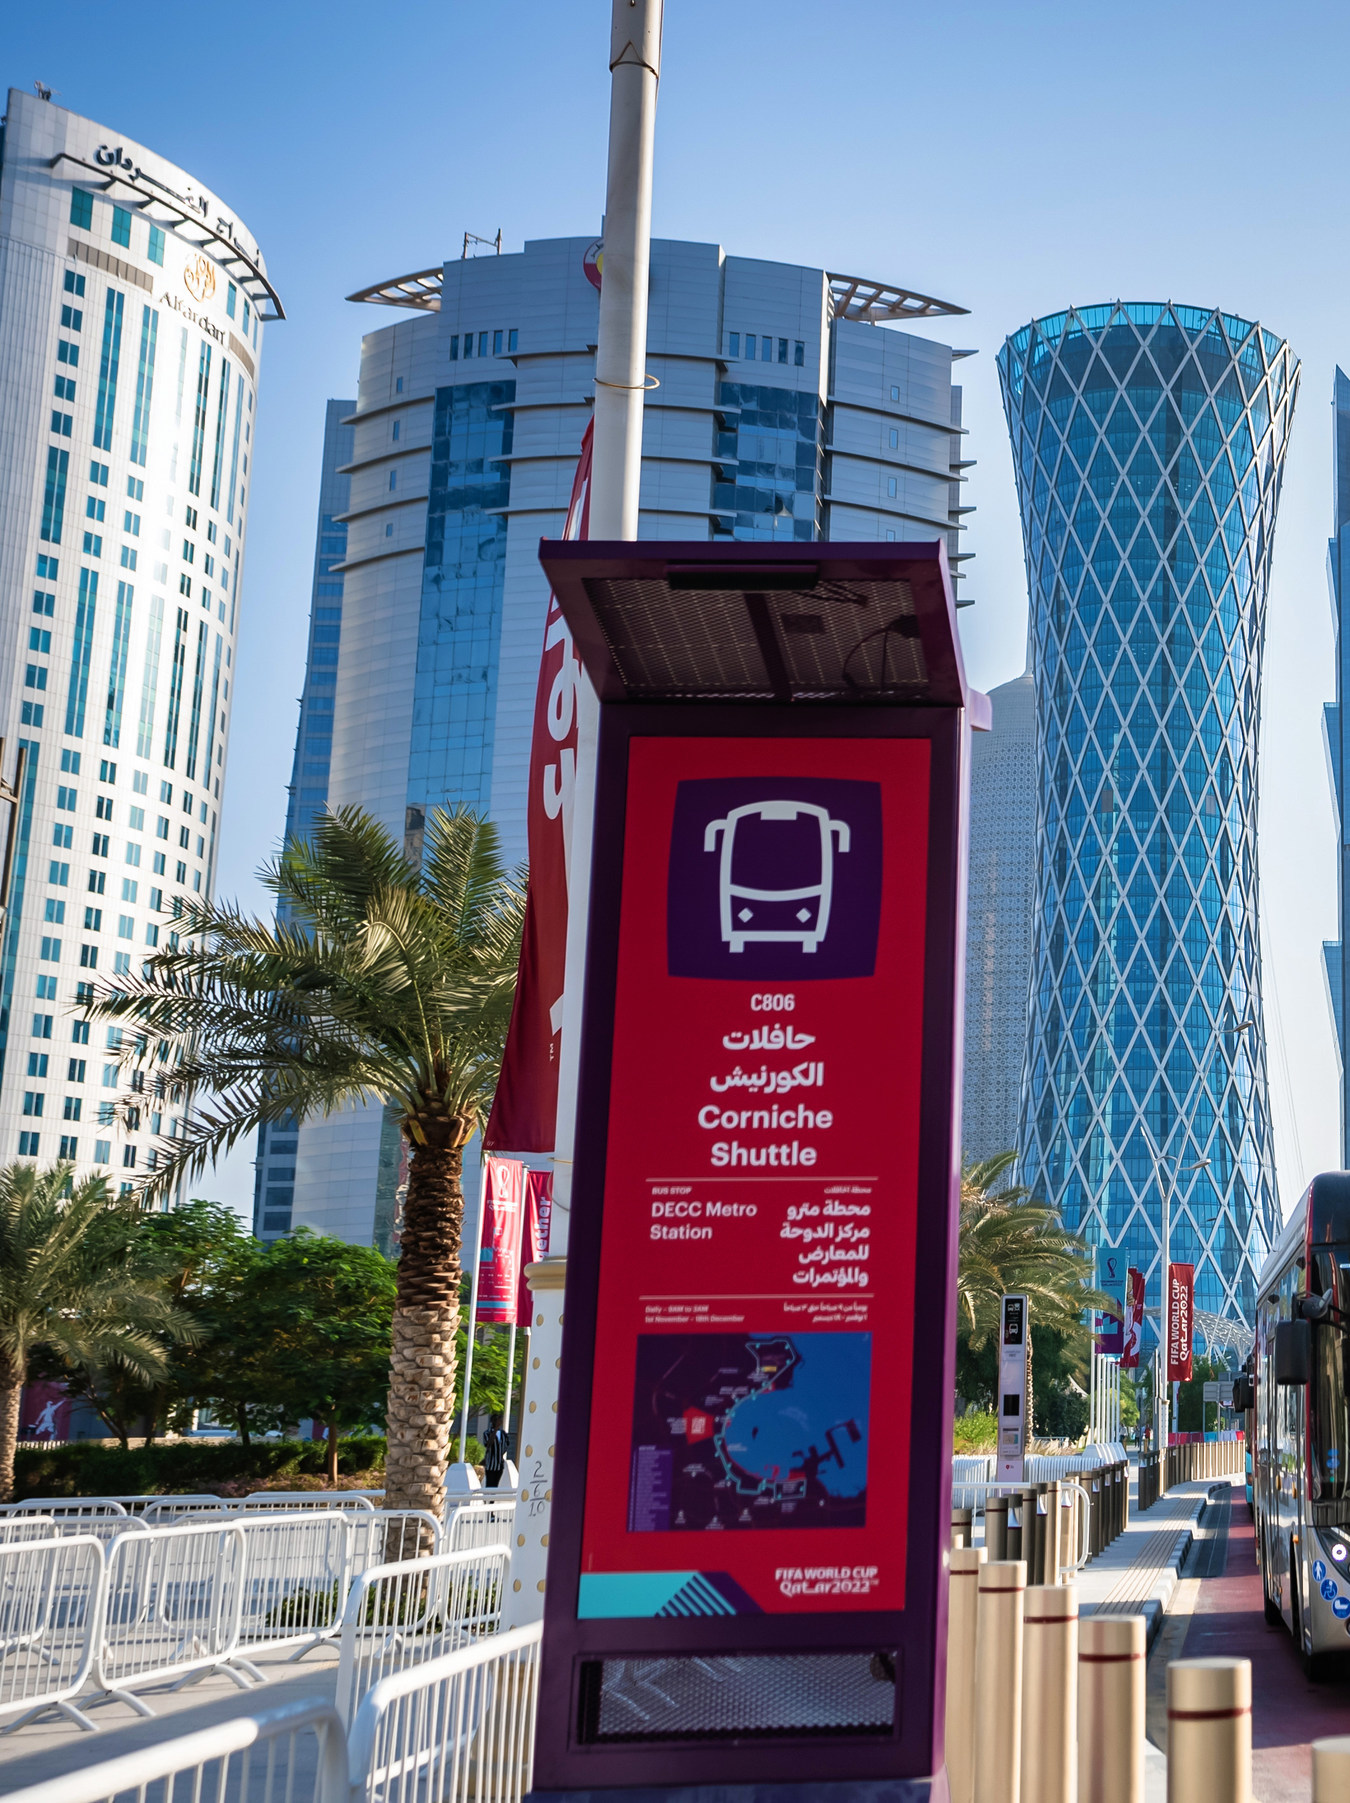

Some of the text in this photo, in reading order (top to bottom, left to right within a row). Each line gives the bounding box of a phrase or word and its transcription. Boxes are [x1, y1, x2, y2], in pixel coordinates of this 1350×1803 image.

[159, 291, 226, 346] Alfardan
[751, 994, 795, 1011] C806
[722, 1023, 816, 1050] حافلات
[710, 1062, 824, 1093] الكورنيش
[697, 1104, 833, 1129] Corniche
[710, 1141, 817, 1167] Shuttle
[651, 1201, 757, 1217] DECC Metro
[787, 1200, 871, 1220] محطة مترو
[650, 1224, 712, 1240] Station
[780, 1222, 870, 1242] مركز الدوحة
[799, 1244, 869, 1264] للمعارض
[793, 1267, 868, 1287] والمؤتمرات
[1171, 1301, 1179, 1340] WORLD
[1171, 1341, 1179, 1365] FIFA
[533, 1461, 544, 1477] 2
[775, 1565, 878, 1580] FIFA WORLD CUP
